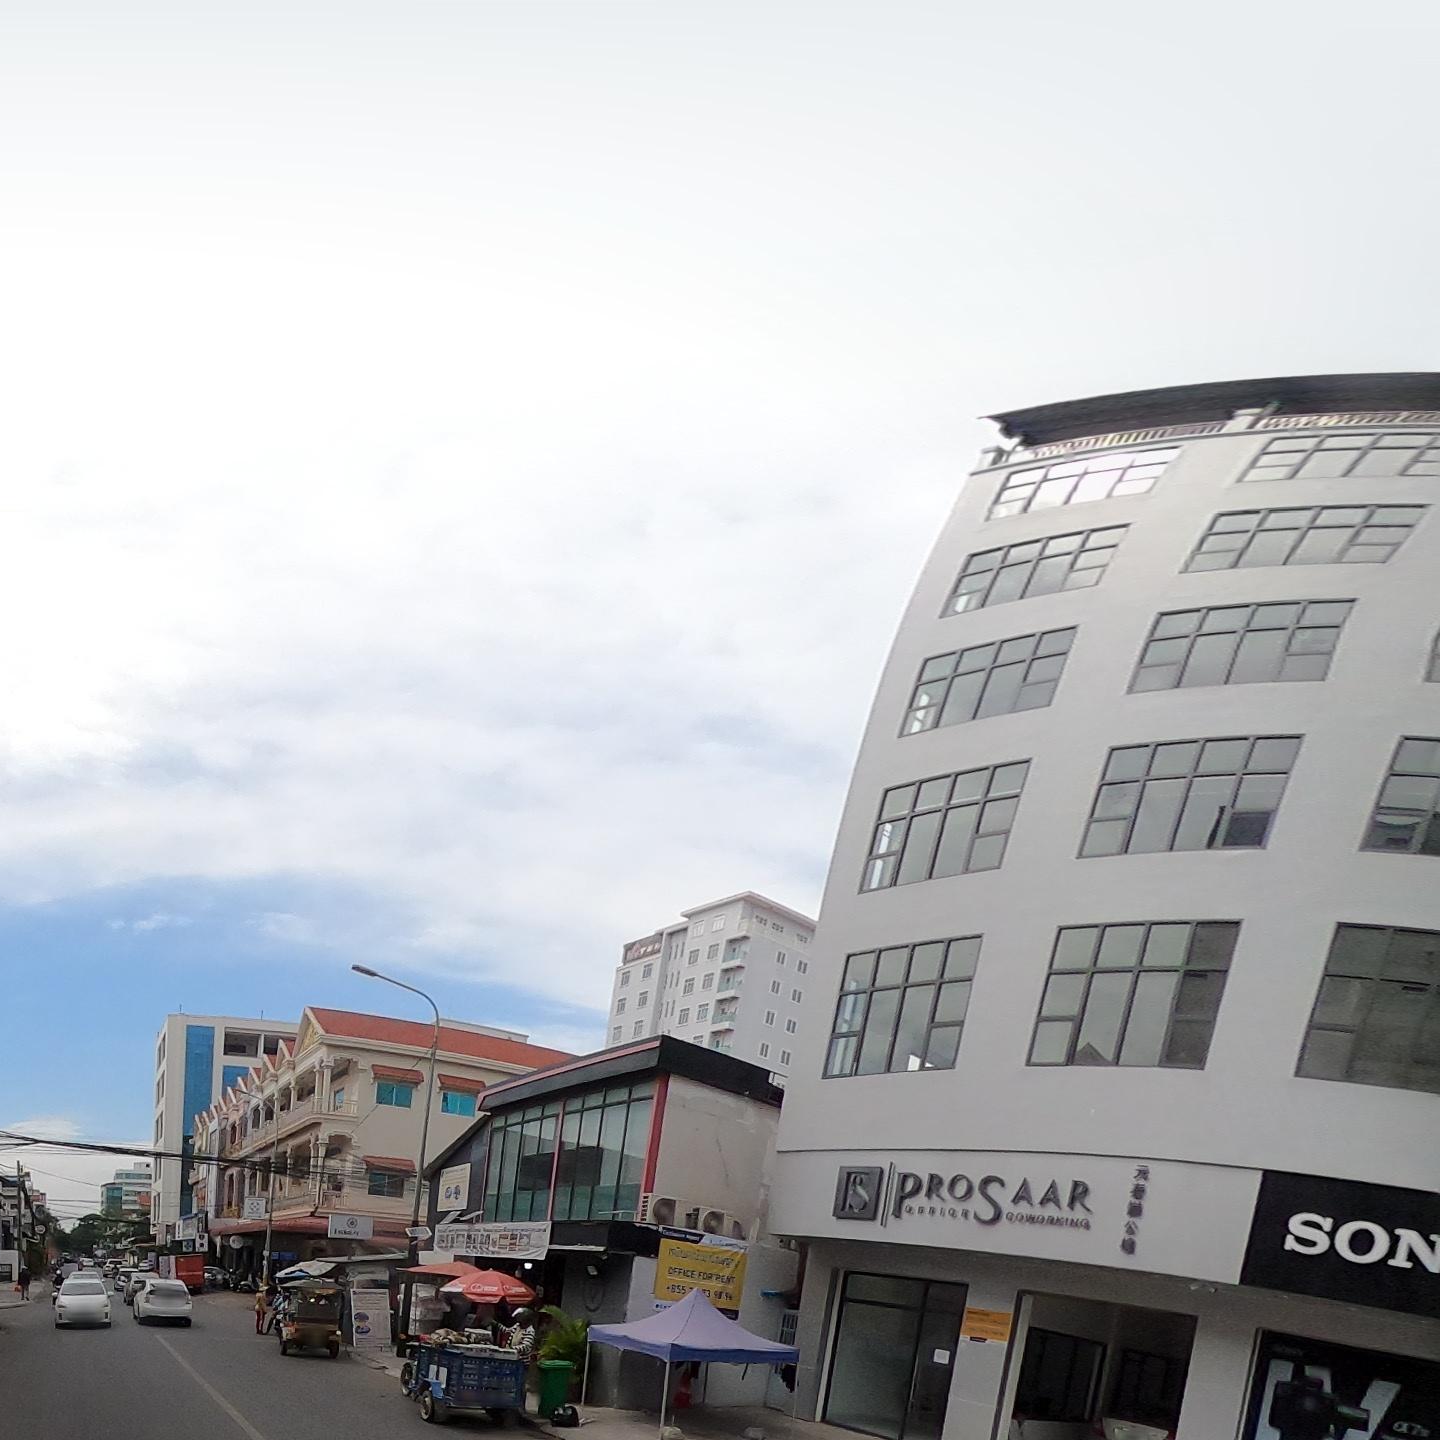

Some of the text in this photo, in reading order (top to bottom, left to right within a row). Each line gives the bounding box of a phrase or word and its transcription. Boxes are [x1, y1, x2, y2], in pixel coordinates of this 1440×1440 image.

[1006, 1211, 1092, 1231] COWORKING
[668, 1266, 697, 1279] OFFICE
[698, 1271, 713, 1281] FOR
